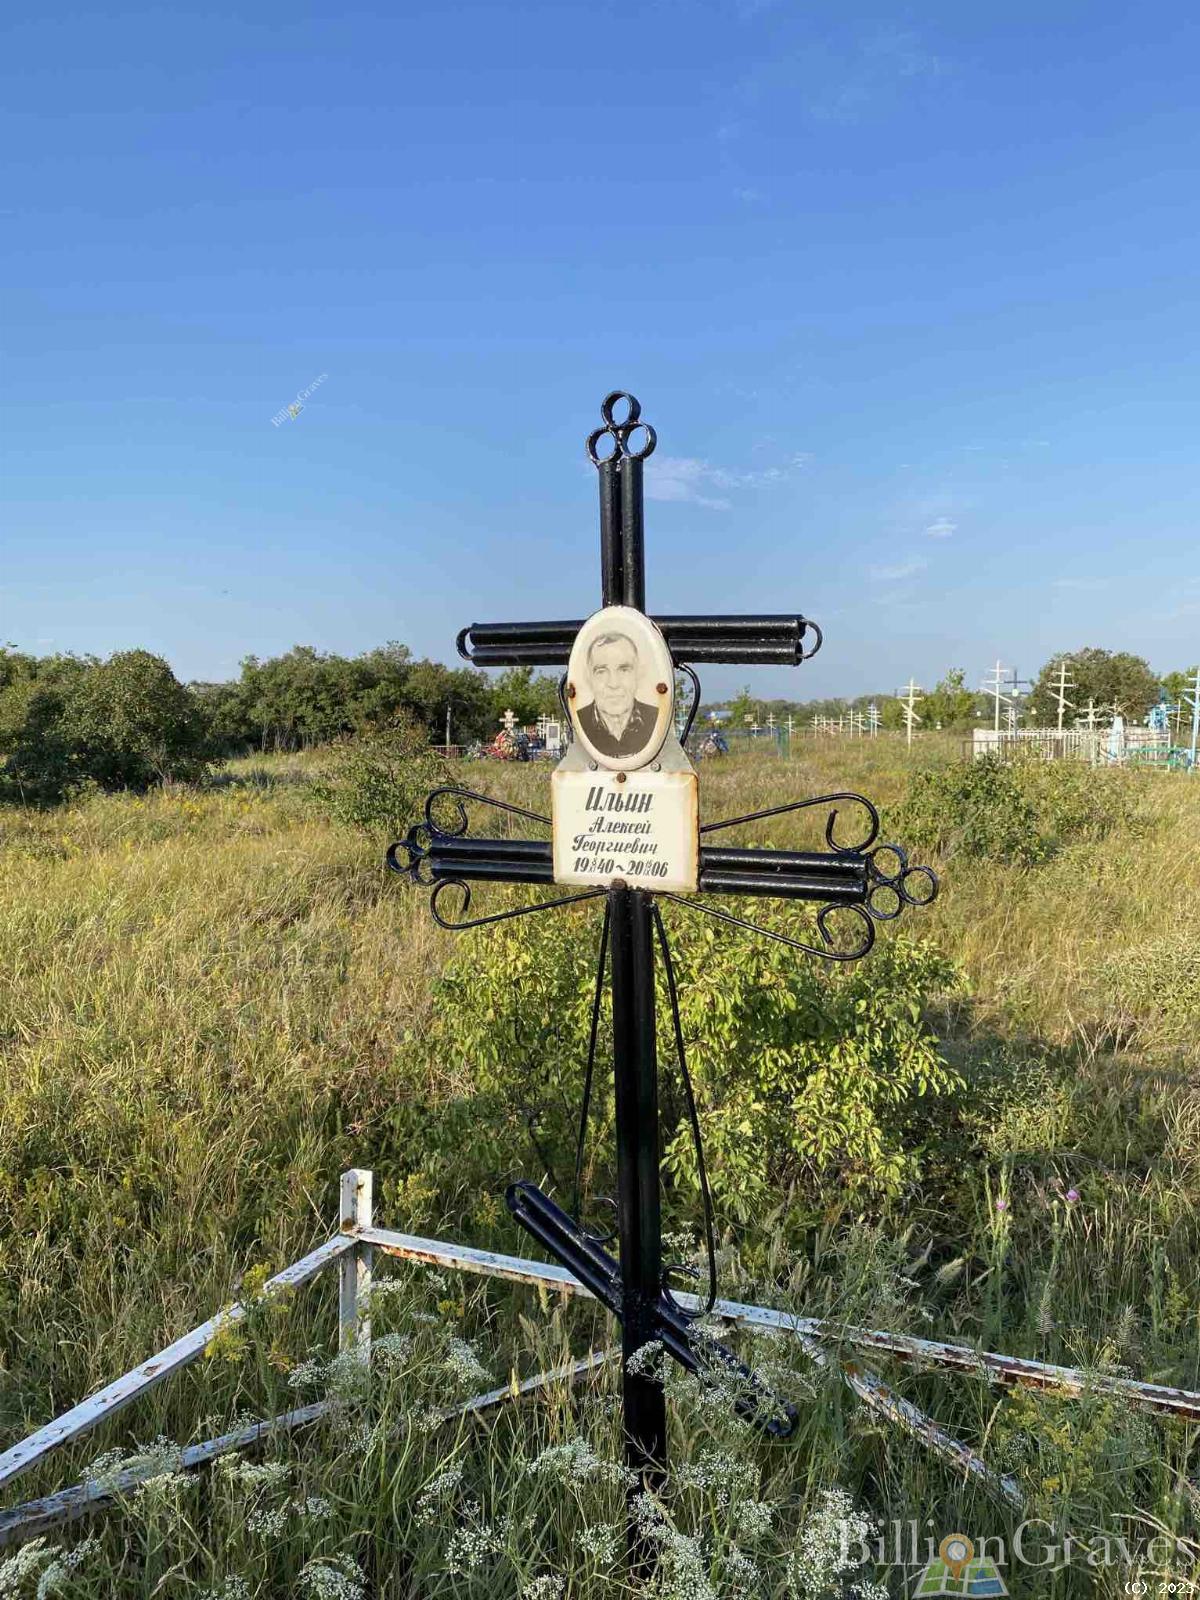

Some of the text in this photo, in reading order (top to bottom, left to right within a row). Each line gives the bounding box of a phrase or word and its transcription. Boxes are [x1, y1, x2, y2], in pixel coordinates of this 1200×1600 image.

[585, 786, 653, 813] Ильин
[589, 816, 651, 835] Алексей
[572, 834, 658, 856] Георгиевич
